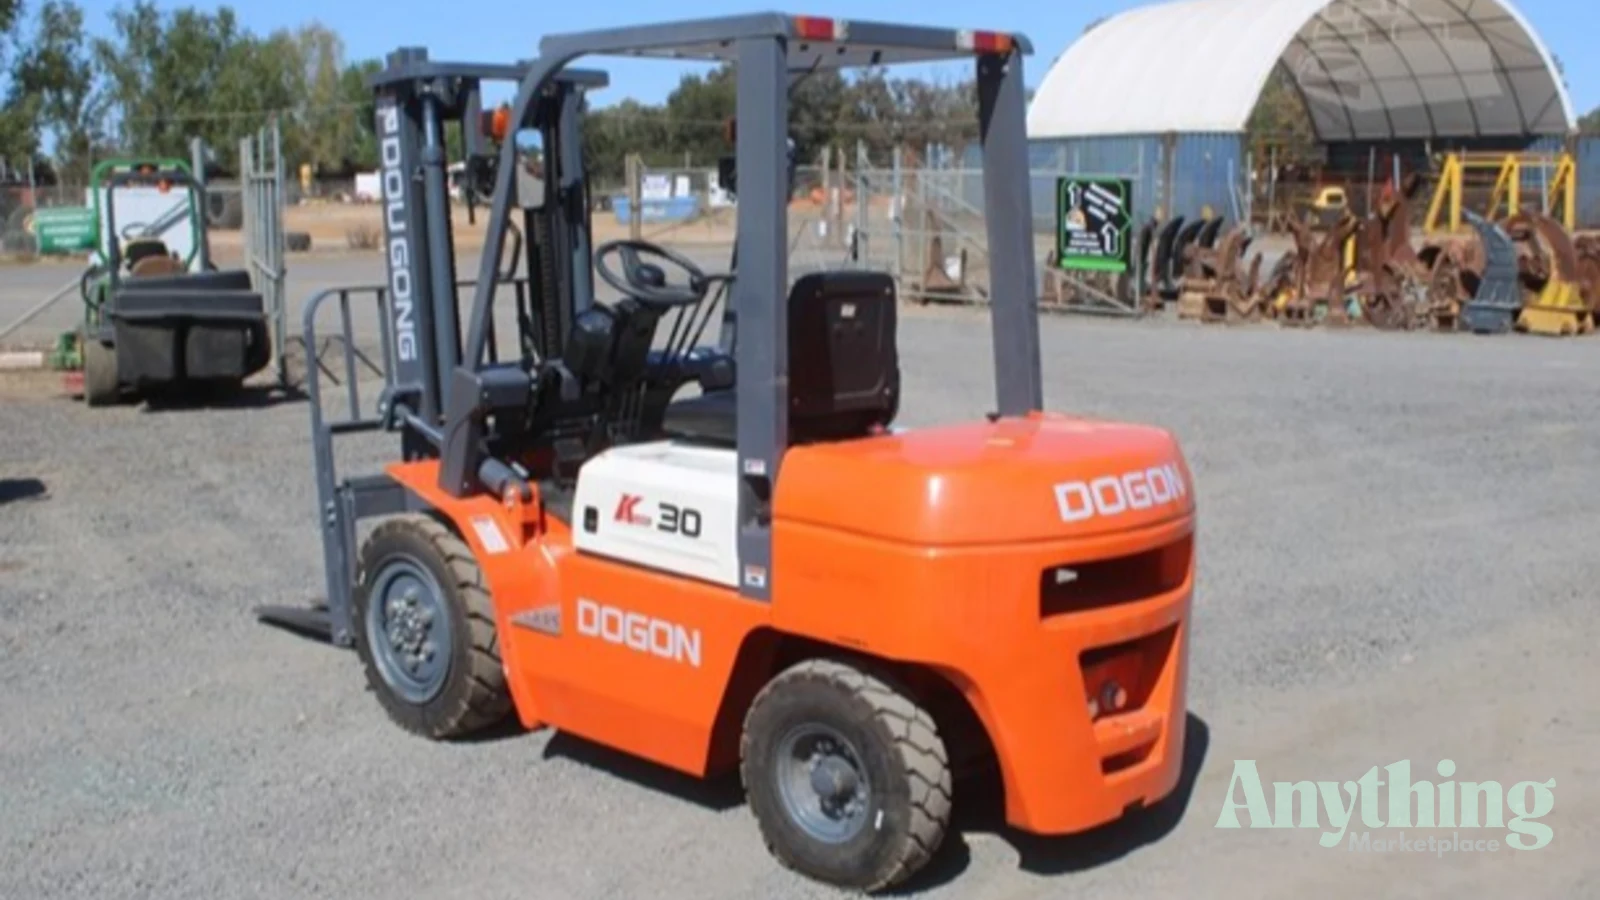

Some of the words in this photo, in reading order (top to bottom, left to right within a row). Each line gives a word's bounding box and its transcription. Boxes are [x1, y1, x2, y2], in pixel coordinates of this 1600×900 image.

[657, 501, 702, 538] 30
[1054, 461, 1184, 523] DOGON
[576, 598, 702, 667] DOGON
